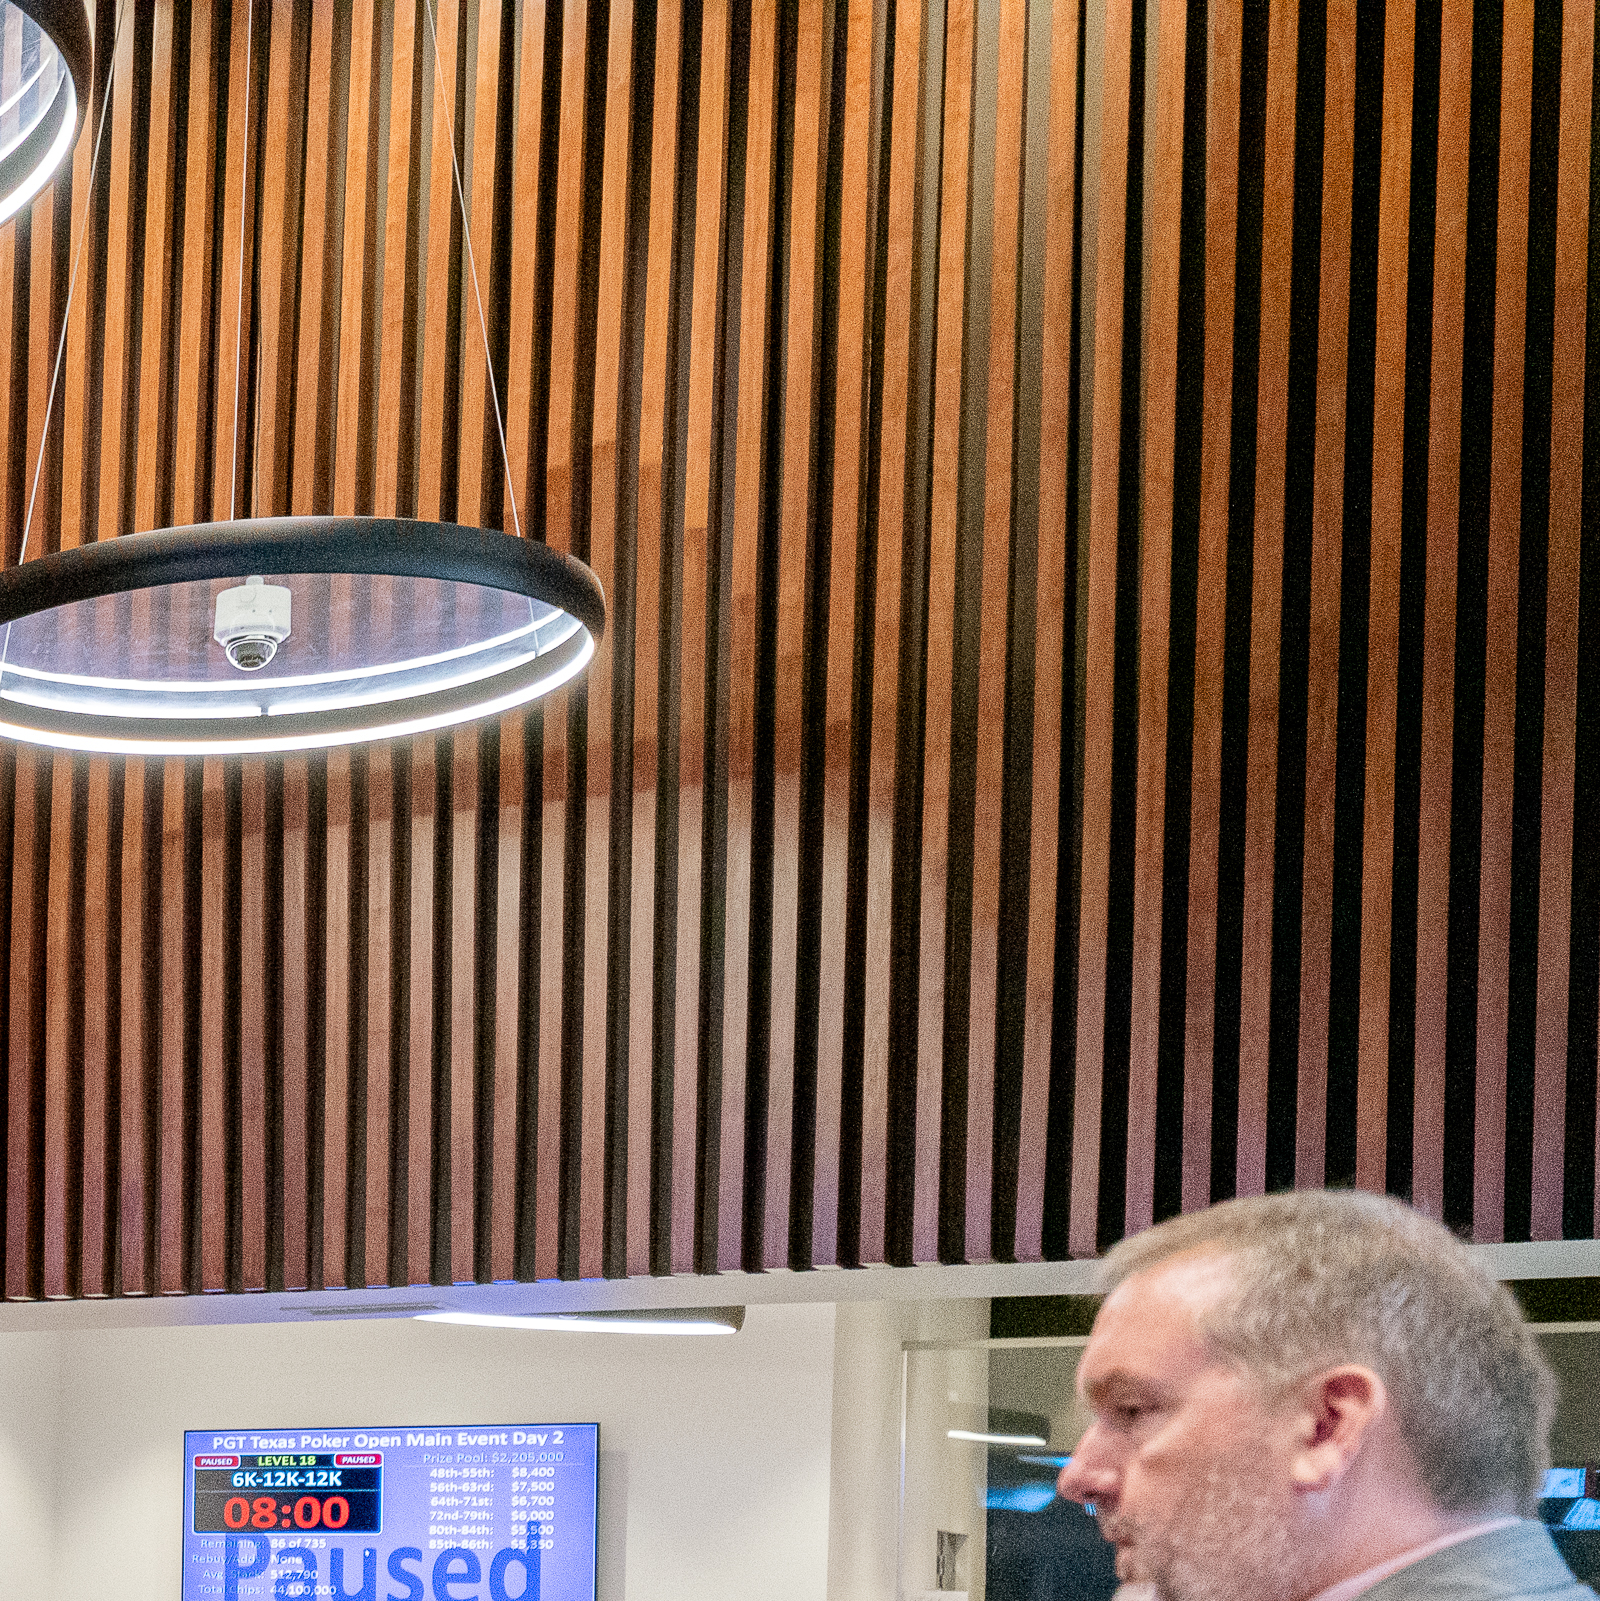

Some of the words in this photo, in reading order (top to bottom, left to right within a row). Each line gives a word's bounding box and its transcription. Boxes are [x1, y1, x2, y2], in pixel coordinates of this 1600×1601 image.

[213, 1436, 246, 1449] PGT
[250, 1435, 296, 1449] Texas
[301, 1434, 350, 1448] Poker
[354, 1433, 401, 1450] Open
[407, 1432, 452, 1447] Main
[457, 1432, 508, 1446] Event
[513, 1431, 548, 1448] Day
[552, 1431, 564, 1444] 2
[200, 1457, 233, 1466] PAUSED
[257, 1456, 296, 1466] LEVEL
[299, 1455, 316, 1466] 18
[341, 1455, 376, 1464] PAUSED
[423, 1453, 452, 1463] Prize
[457, 1452, 488, 1463] Pool:
[492, 1451, 564, 1464] $2,205,000
[231, 1471, 342, 1487] 6K-12K-12K
[511, 1466, 555, 1479] $8,400
[511, 1481, 555, 1494] $7,500
[511, 1496, 555, 1508] $6,700
[224, 1496, 350, 1529] 08:00
[511, 1510, 555, 1523] $6,000
[201, 1539, 265, 1550] Remaining:
[271, 1539, 286, 1548] 86
[288, 1538, 301, 1548] of
[304, 1539, 326, 1549] 735
[270, 1554, 302, 1564] None
[270, 1570, 318, 1581] 512,790
[199, 1585, 225, 1594] Total
[270, 1585, 336, 1596] 44,100,000
